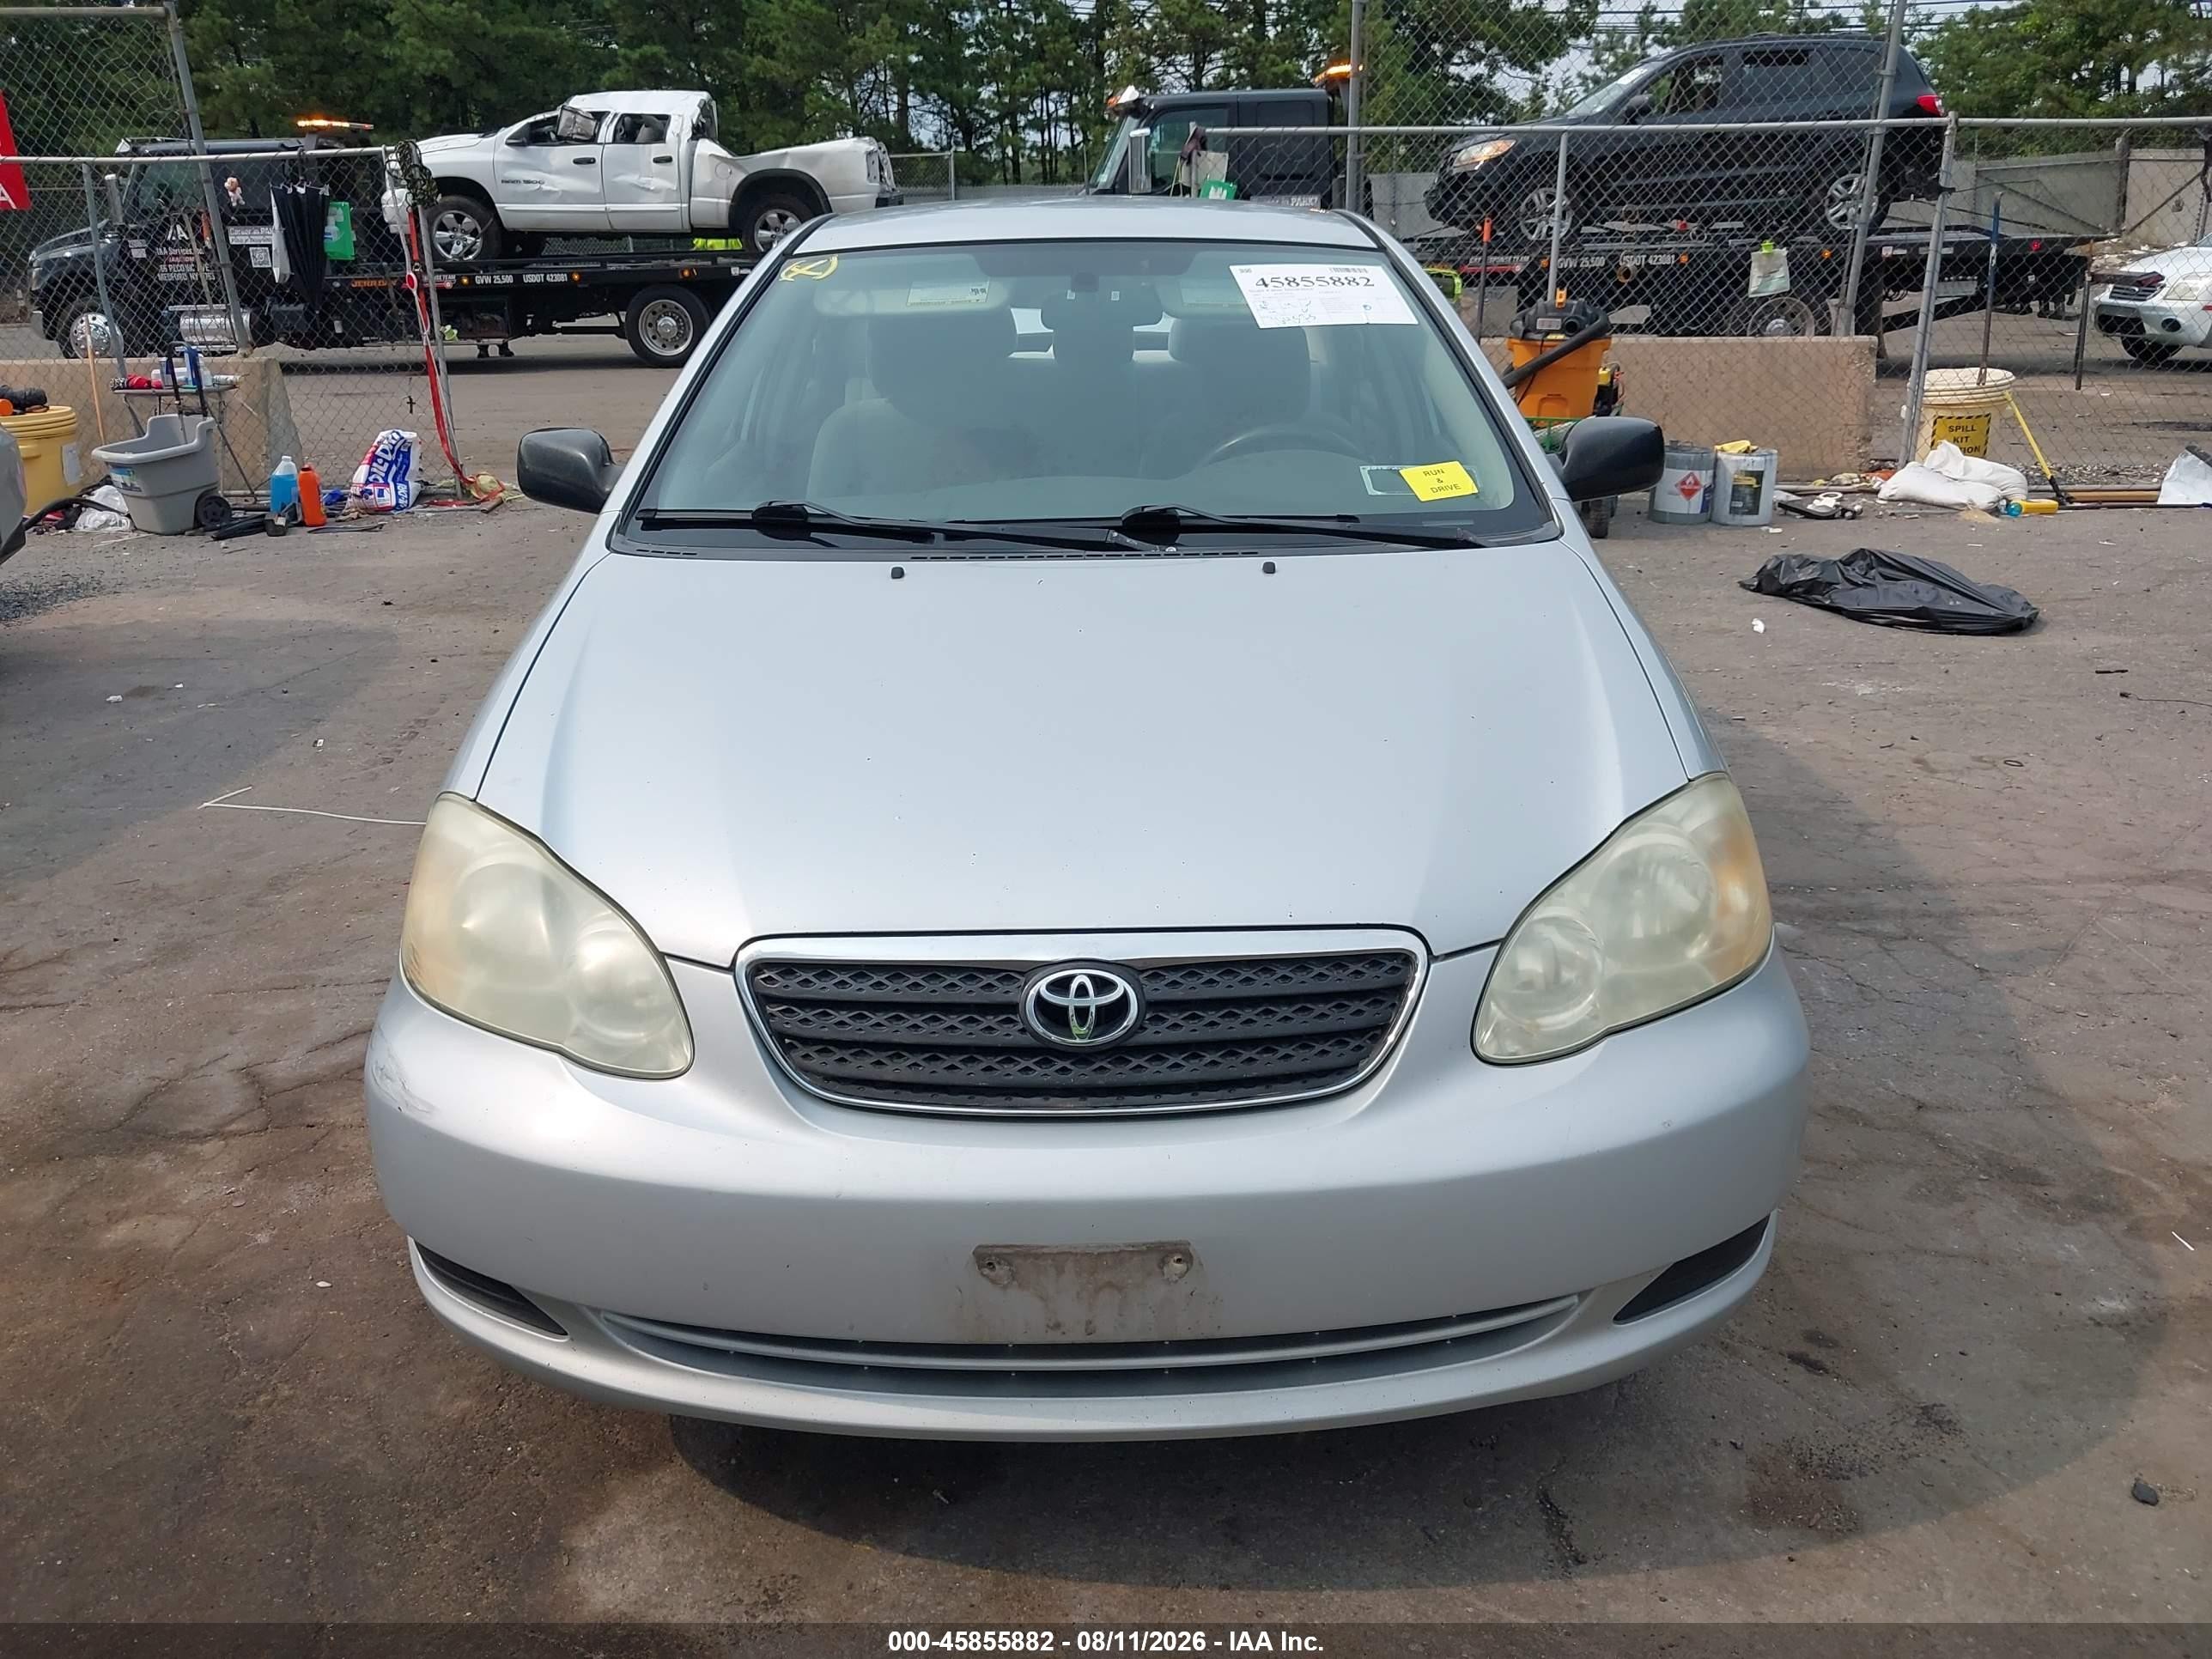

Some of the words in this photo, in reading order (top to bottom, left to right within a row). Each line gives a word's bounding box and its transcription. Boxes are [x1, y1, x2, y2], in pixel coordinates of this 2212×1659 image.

[474, 275, 492, 284] GVW
[493, 274, 514, 284] 25,500
[522, 273, 545, 283] USDOT
[546, 273, 568, 283] 423081
[1255, 276, 1376, 289] 45855882
[1422, 468, 1445, 477] RUN
[1430, 483, 1462, 494] DRIVE
